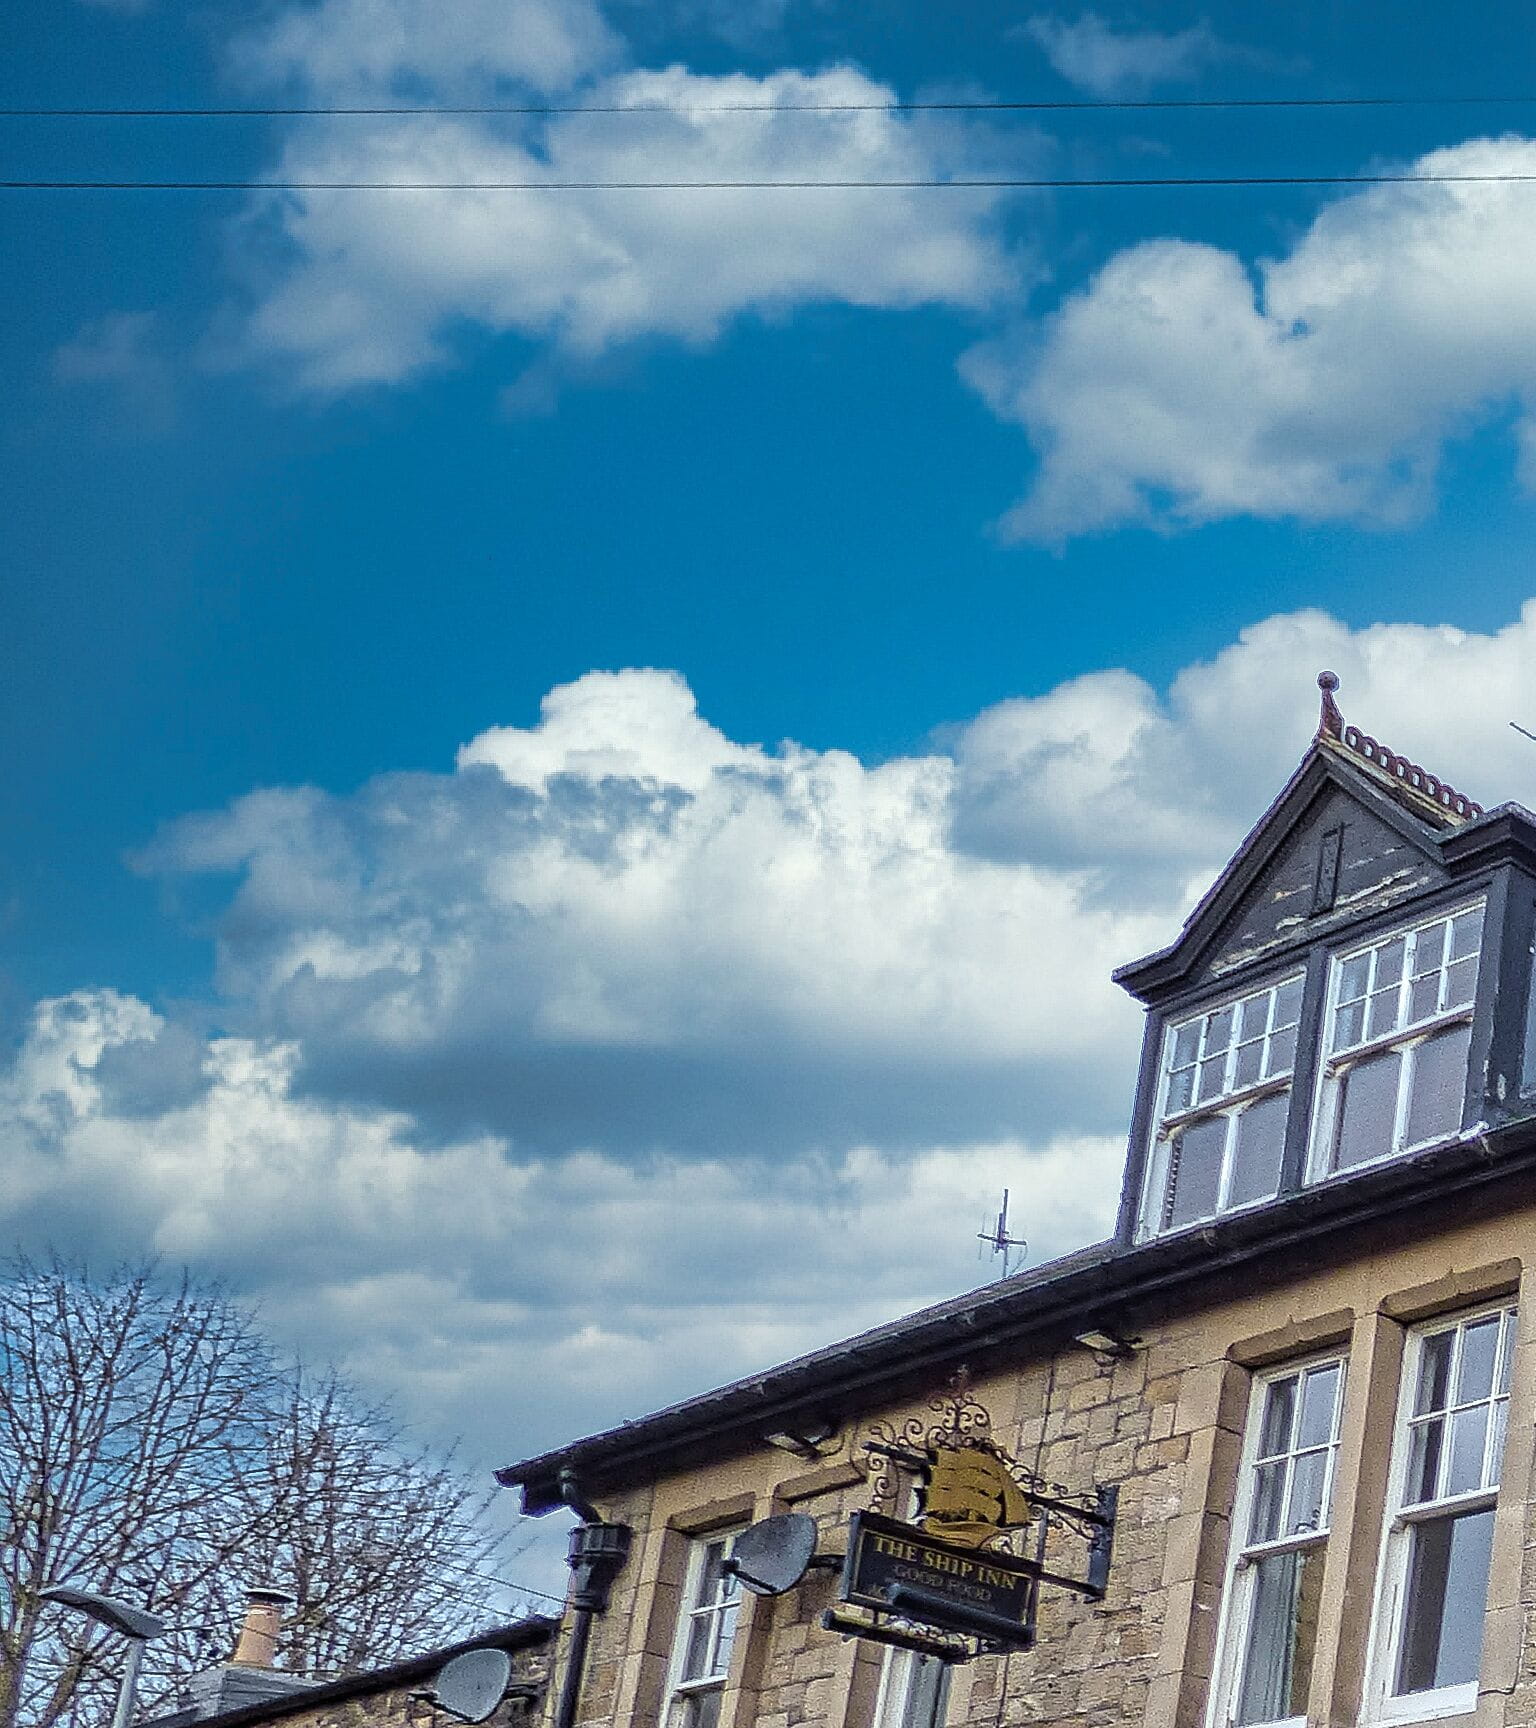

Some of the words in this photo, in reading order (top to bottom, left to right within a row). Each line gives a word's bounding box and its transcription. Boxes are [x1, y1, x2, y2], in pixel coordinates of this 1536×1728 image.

[875, 1535, 917, 1563] THE
[922, 1551, 974, 1577] SHIP
[977, 1566, 1018, 1590] INN
